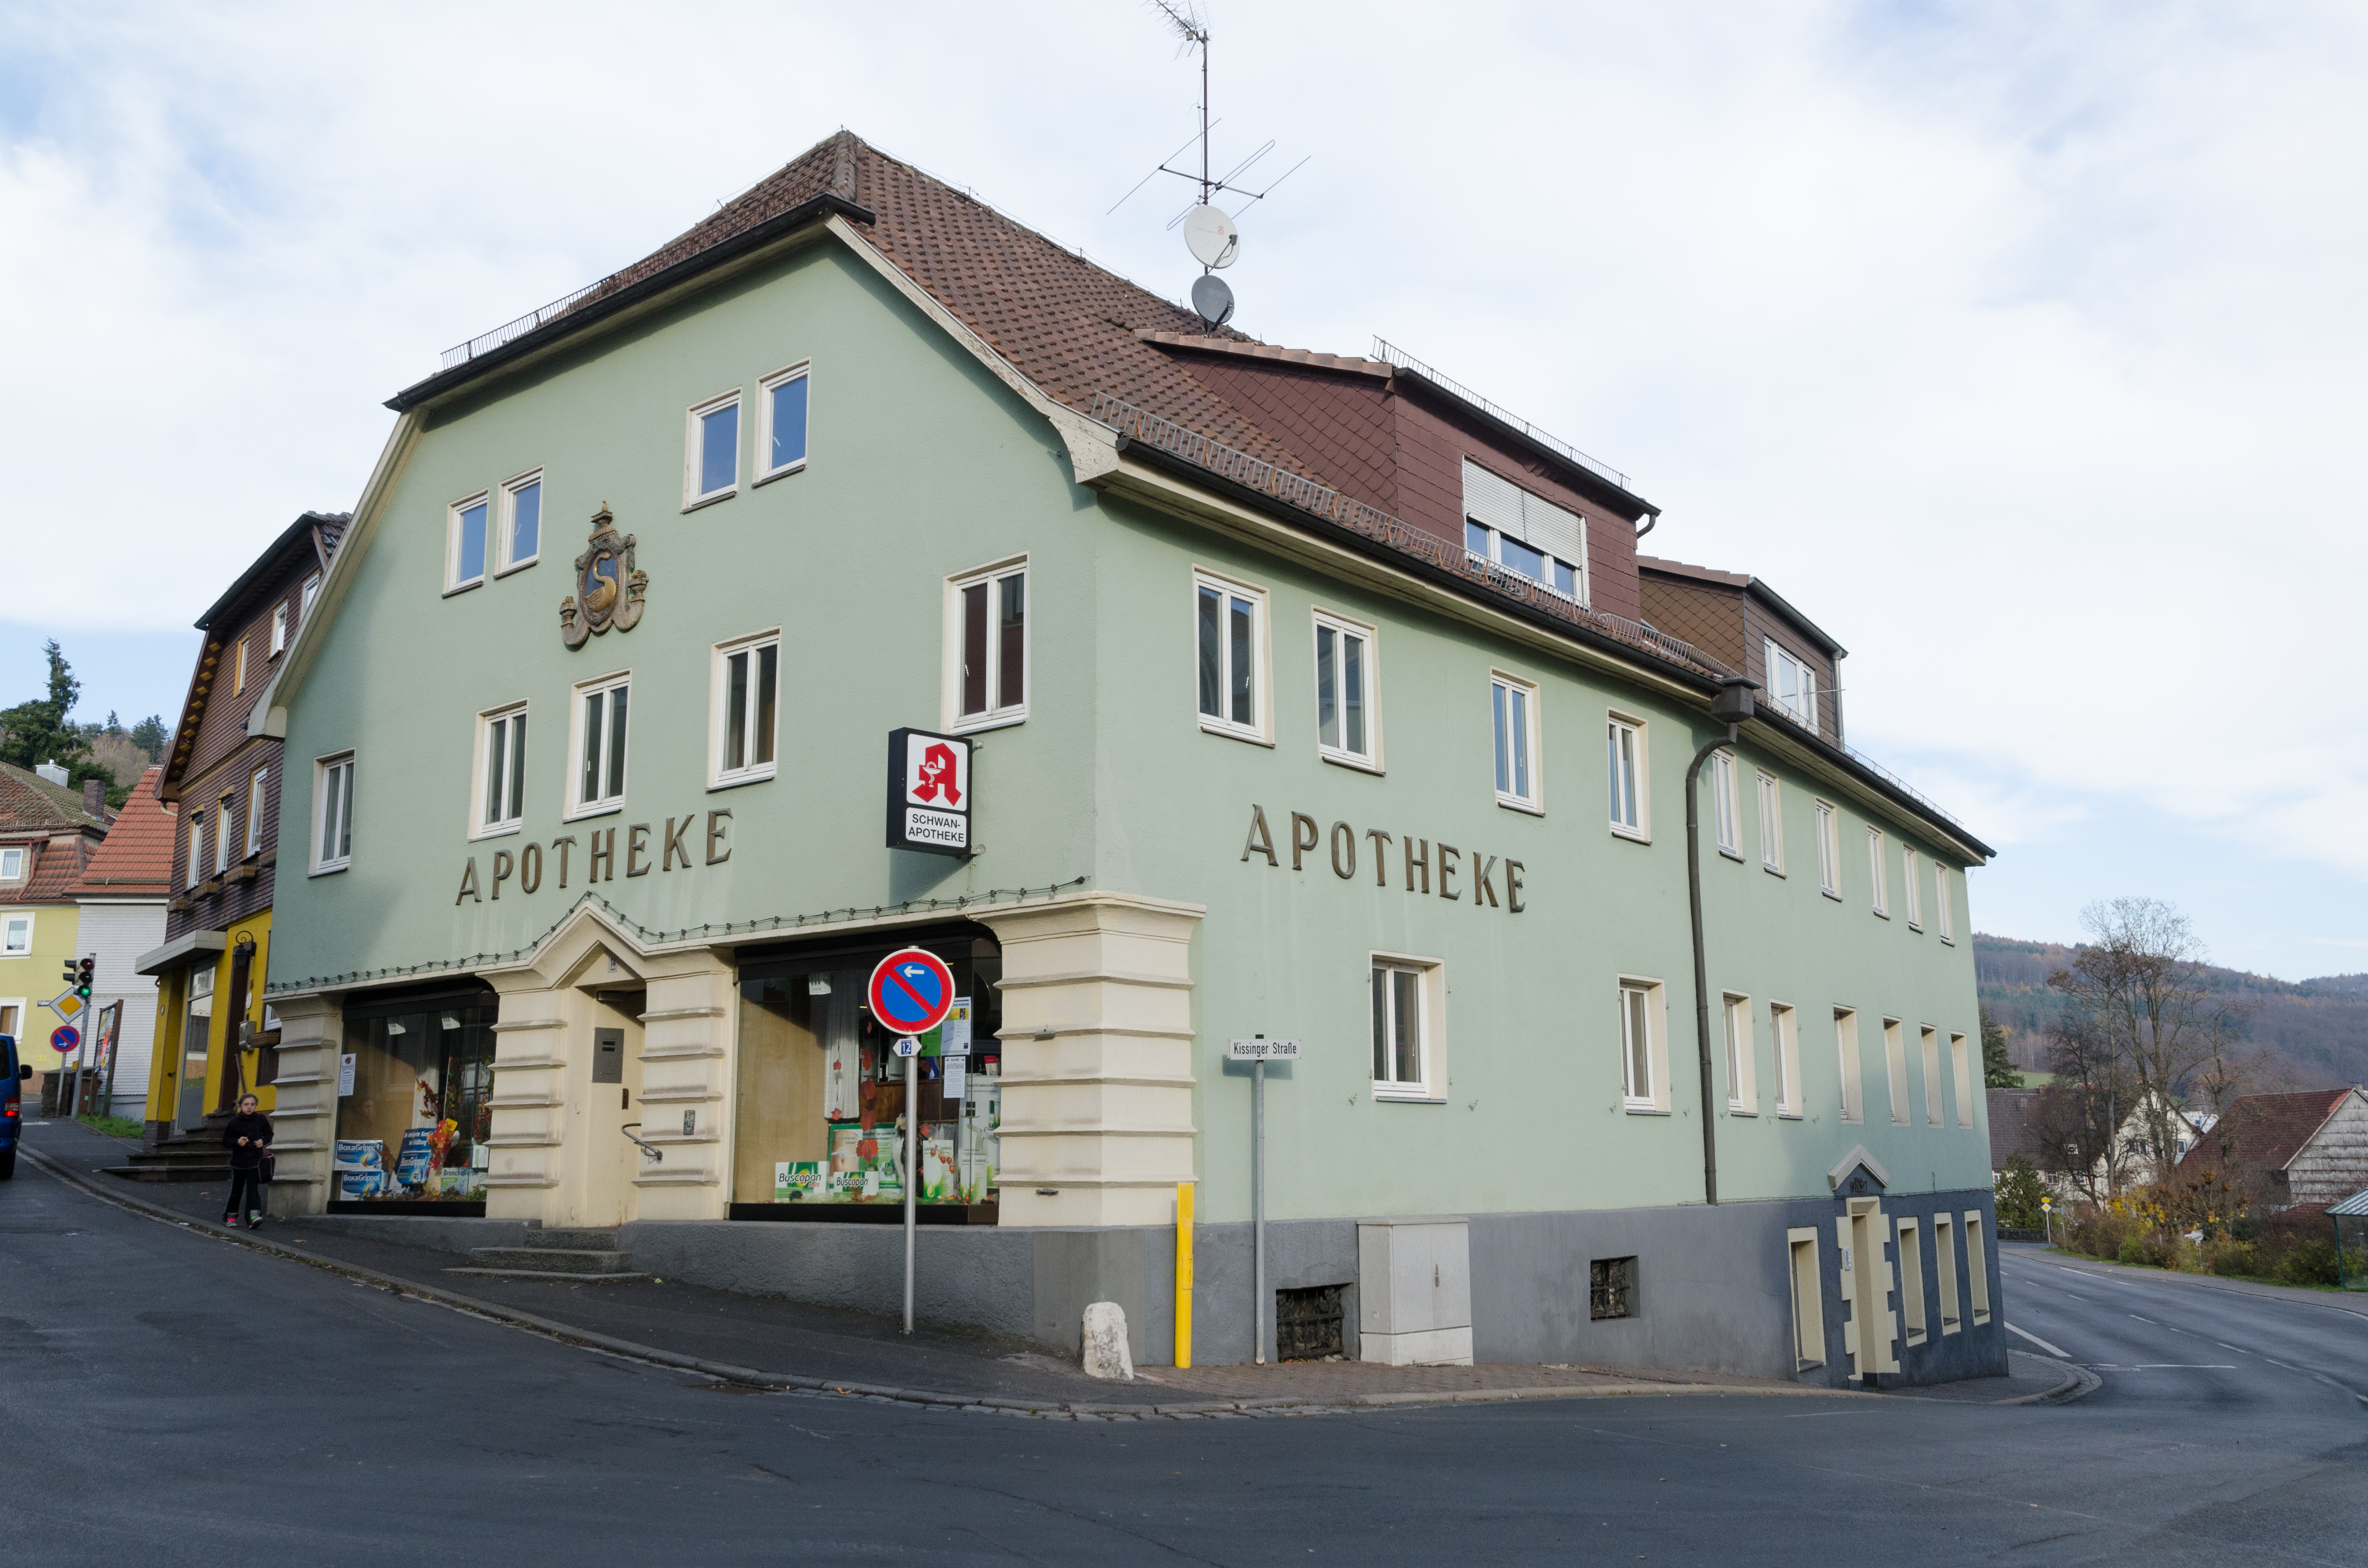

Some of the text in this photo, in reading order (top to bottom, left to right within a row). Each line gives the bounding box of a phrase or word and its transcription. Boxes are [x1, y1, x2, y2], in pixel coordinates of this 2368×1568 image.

[912, 814, 961, 829] SCHWAN-
[908, 826, 964, 842] APOTHEKE
[455, 807, 734, 906] APOTHEKE
[1240, 804, 1525, 913] APOTHEKE
[902, 1042, 911, 1052] 12
[1233, 1041, 1297, 1057] Kissinger Straße
[338, 1144, 380, 1152] BoxaGrippl
[401, 1156, 427, 1168] BoxaGrippal
[343, 1174, 381, 1182] BoxaGrippal
[779, 1173, 821, 1184] Buscopan
[837, 1176, 868, 1188] Buscopan
